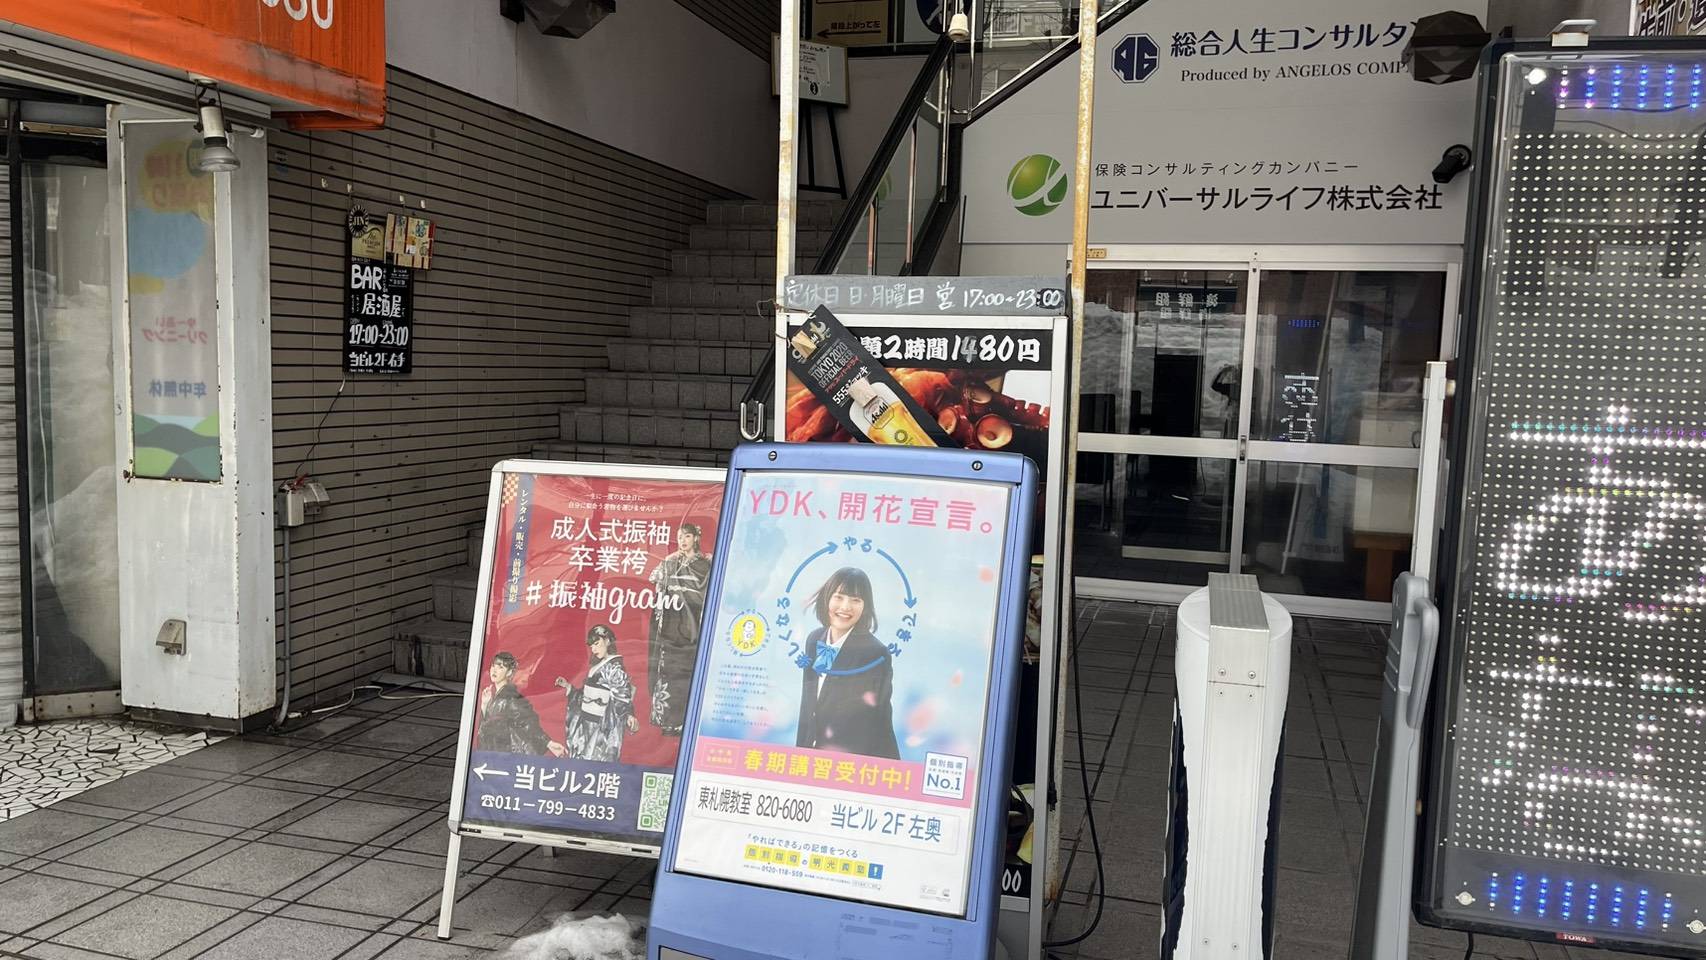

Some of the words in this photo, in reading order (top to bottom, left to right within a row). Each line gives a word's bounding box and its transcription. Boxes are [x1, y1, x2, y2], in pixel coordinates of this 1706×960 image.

[1170, 21, 1417, 59] 総合人生コンサルタ
[1180, 66, 1250, 83] Produced
[1252, 66, 1272, 82] by
[1275, 62, 1352, 80] ANGELOS
[1356, 61, 1410, 76] COMP
[1095, 160, 1359, 178] 保険コンサルティングカンパニー
[1091, 183, 1444, 212] ユニバーサルライフ株式会社
[351, 264, 383, 291] BAR
[361, 292, 402, 318] 居酒屋
[786, 279, 839, 306] 定休日
[811, 356, 834, 381] TOKYO
[831, 342, 849, 363] 2020
[818, 366, 842, 389] OFFICIAL
[839, 350, 854, 368] BEER
[871, 402, 889, 424] Asahi
[749, 489, 993, 534] YDK、開花宣言。
[550, 517, 672, 546] 成人式振袖
[843, 536, 873, 553] やる
[568, 545, 649, 576] 卒業袴
[513, 764, 621, 799] 当ビル2階
[744, 748, 912, 791] 春期講習受付中!
[927, 773, 961, 791] No.1
[697, 785, 753, 815] 東札幌教室
[756, 794, 813, 823] 820-6080
